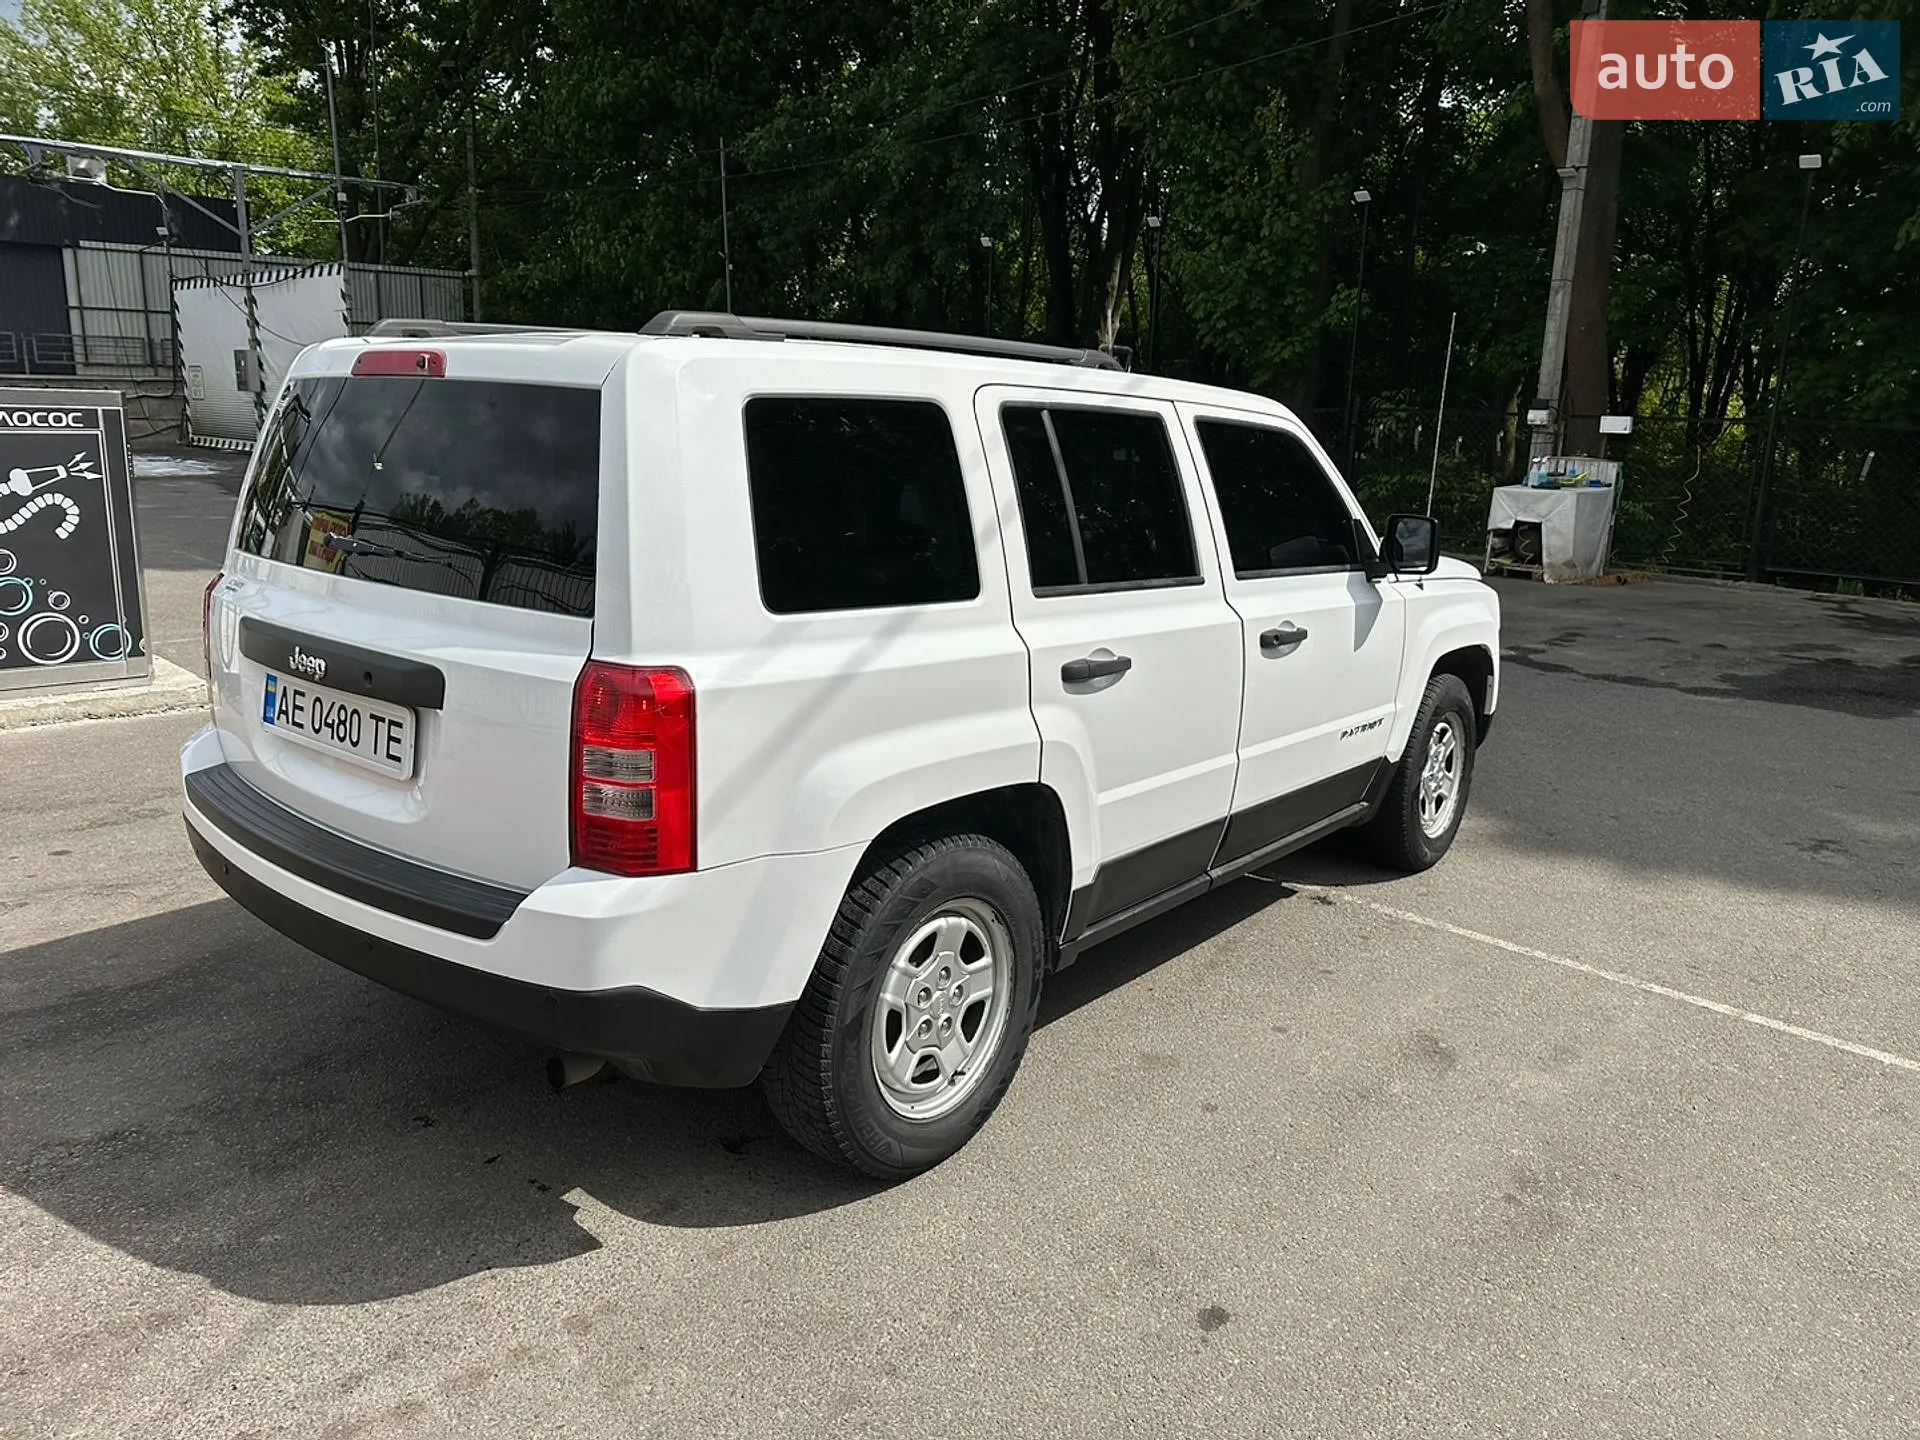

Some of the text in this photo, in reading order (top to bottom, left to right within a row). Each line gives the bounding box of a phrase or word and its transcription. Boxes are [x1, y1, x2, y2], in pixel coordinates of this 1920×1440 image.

[288, 646, 327, 681] Jeep
[276, 685, 404, 763] AE 0480 TE
